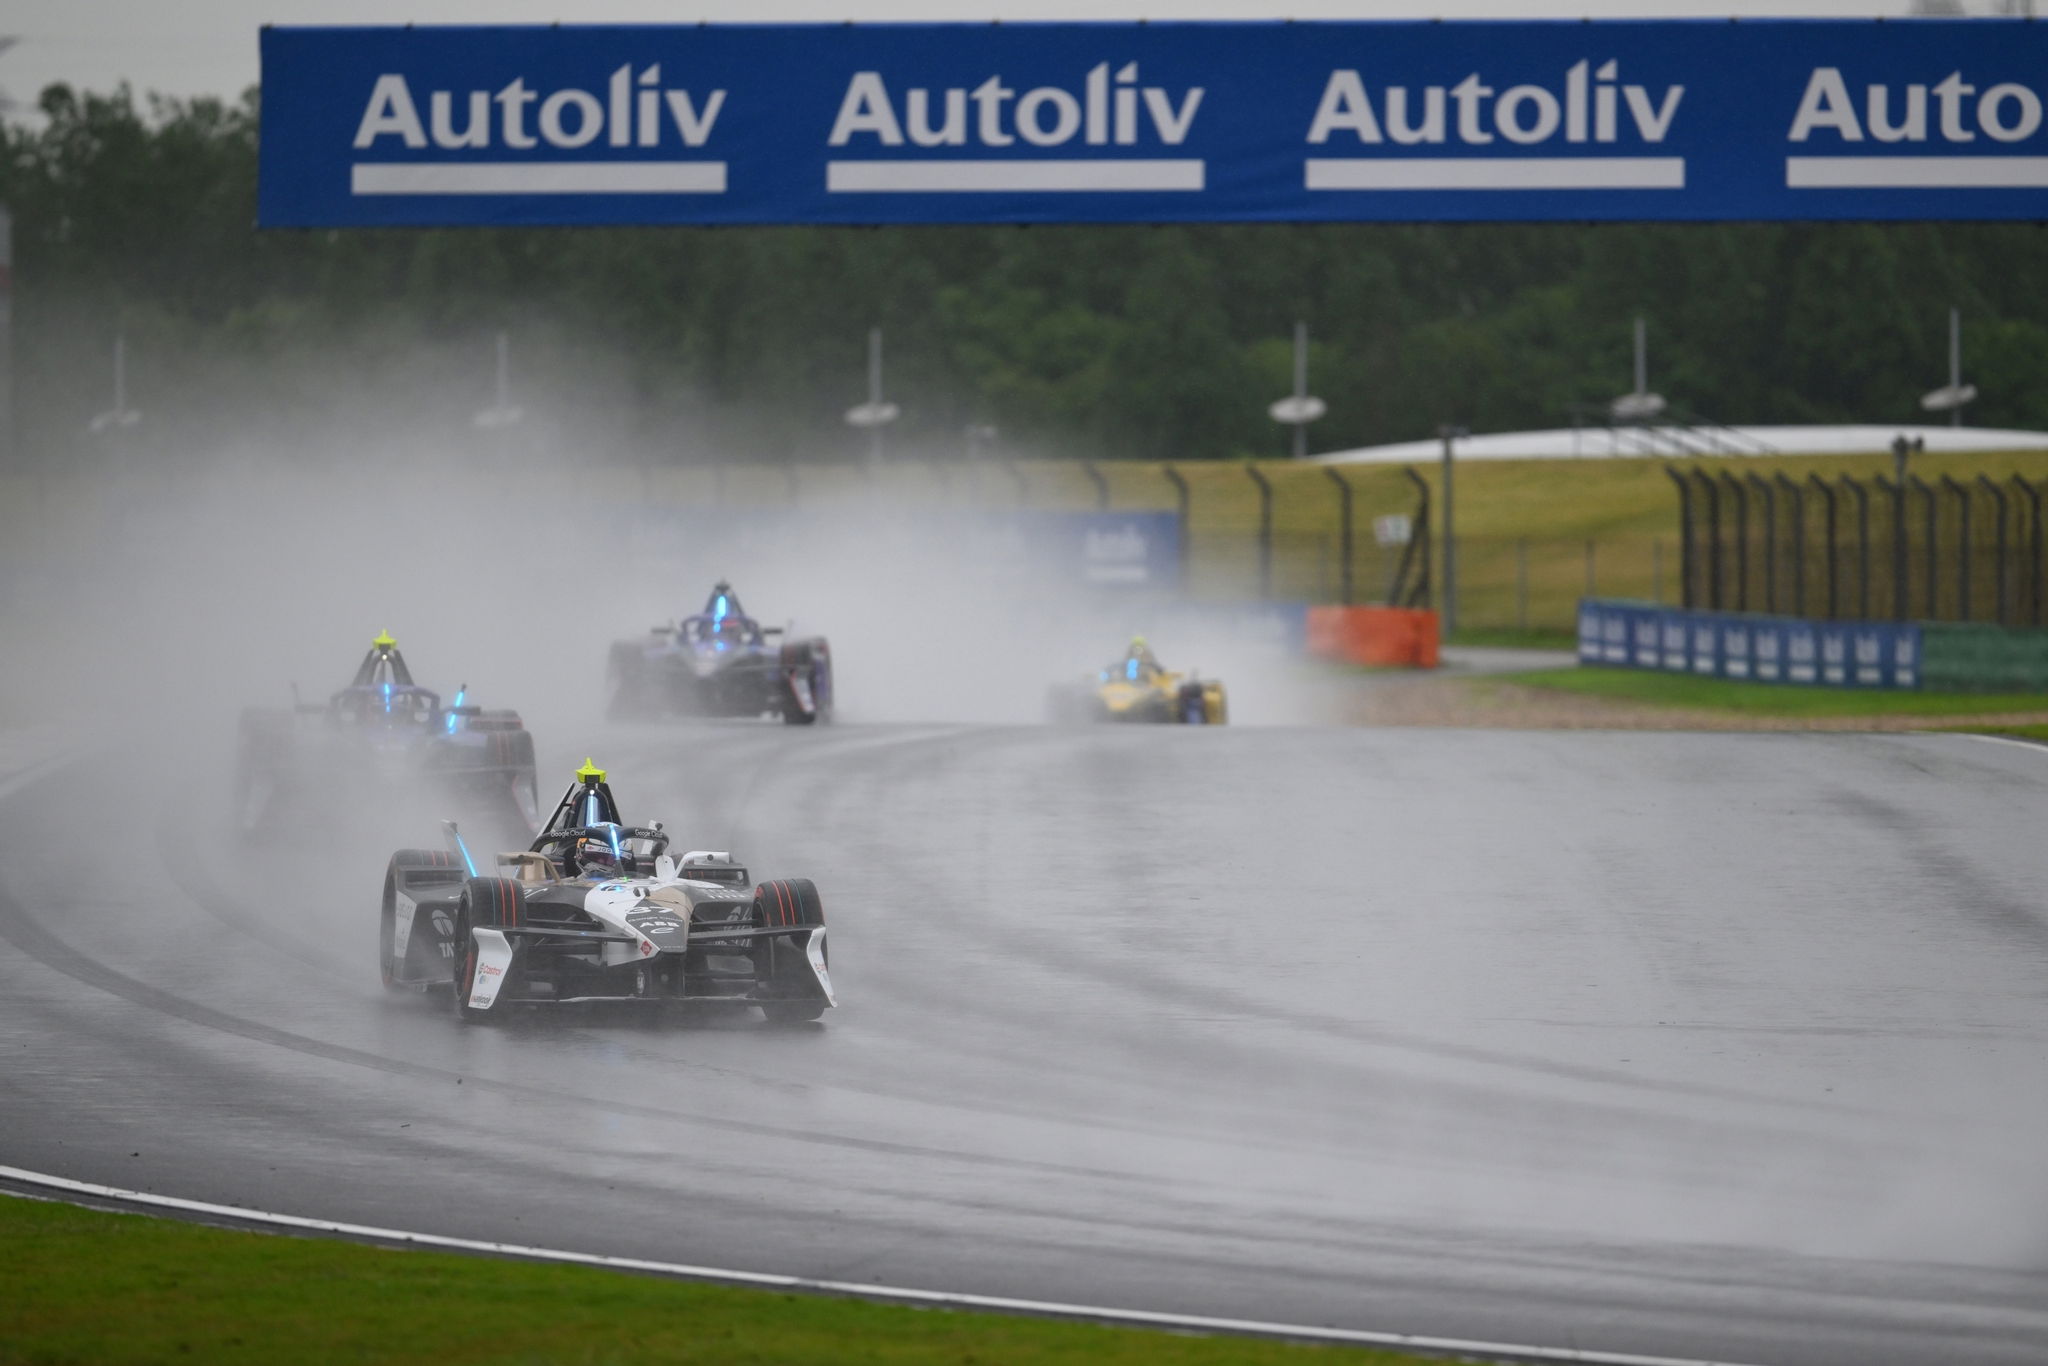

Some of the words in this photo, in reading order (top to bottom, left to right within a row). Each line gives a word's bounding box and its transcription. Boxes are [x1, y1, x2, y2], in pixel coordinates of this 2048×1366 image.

[355, 65, 725, 147] Autoliv
[829, 64, 1203, 145] Autoliv
[1308, 61, 1682, 143] Autoliv
[1789, 69, 2041, 141] Auto
